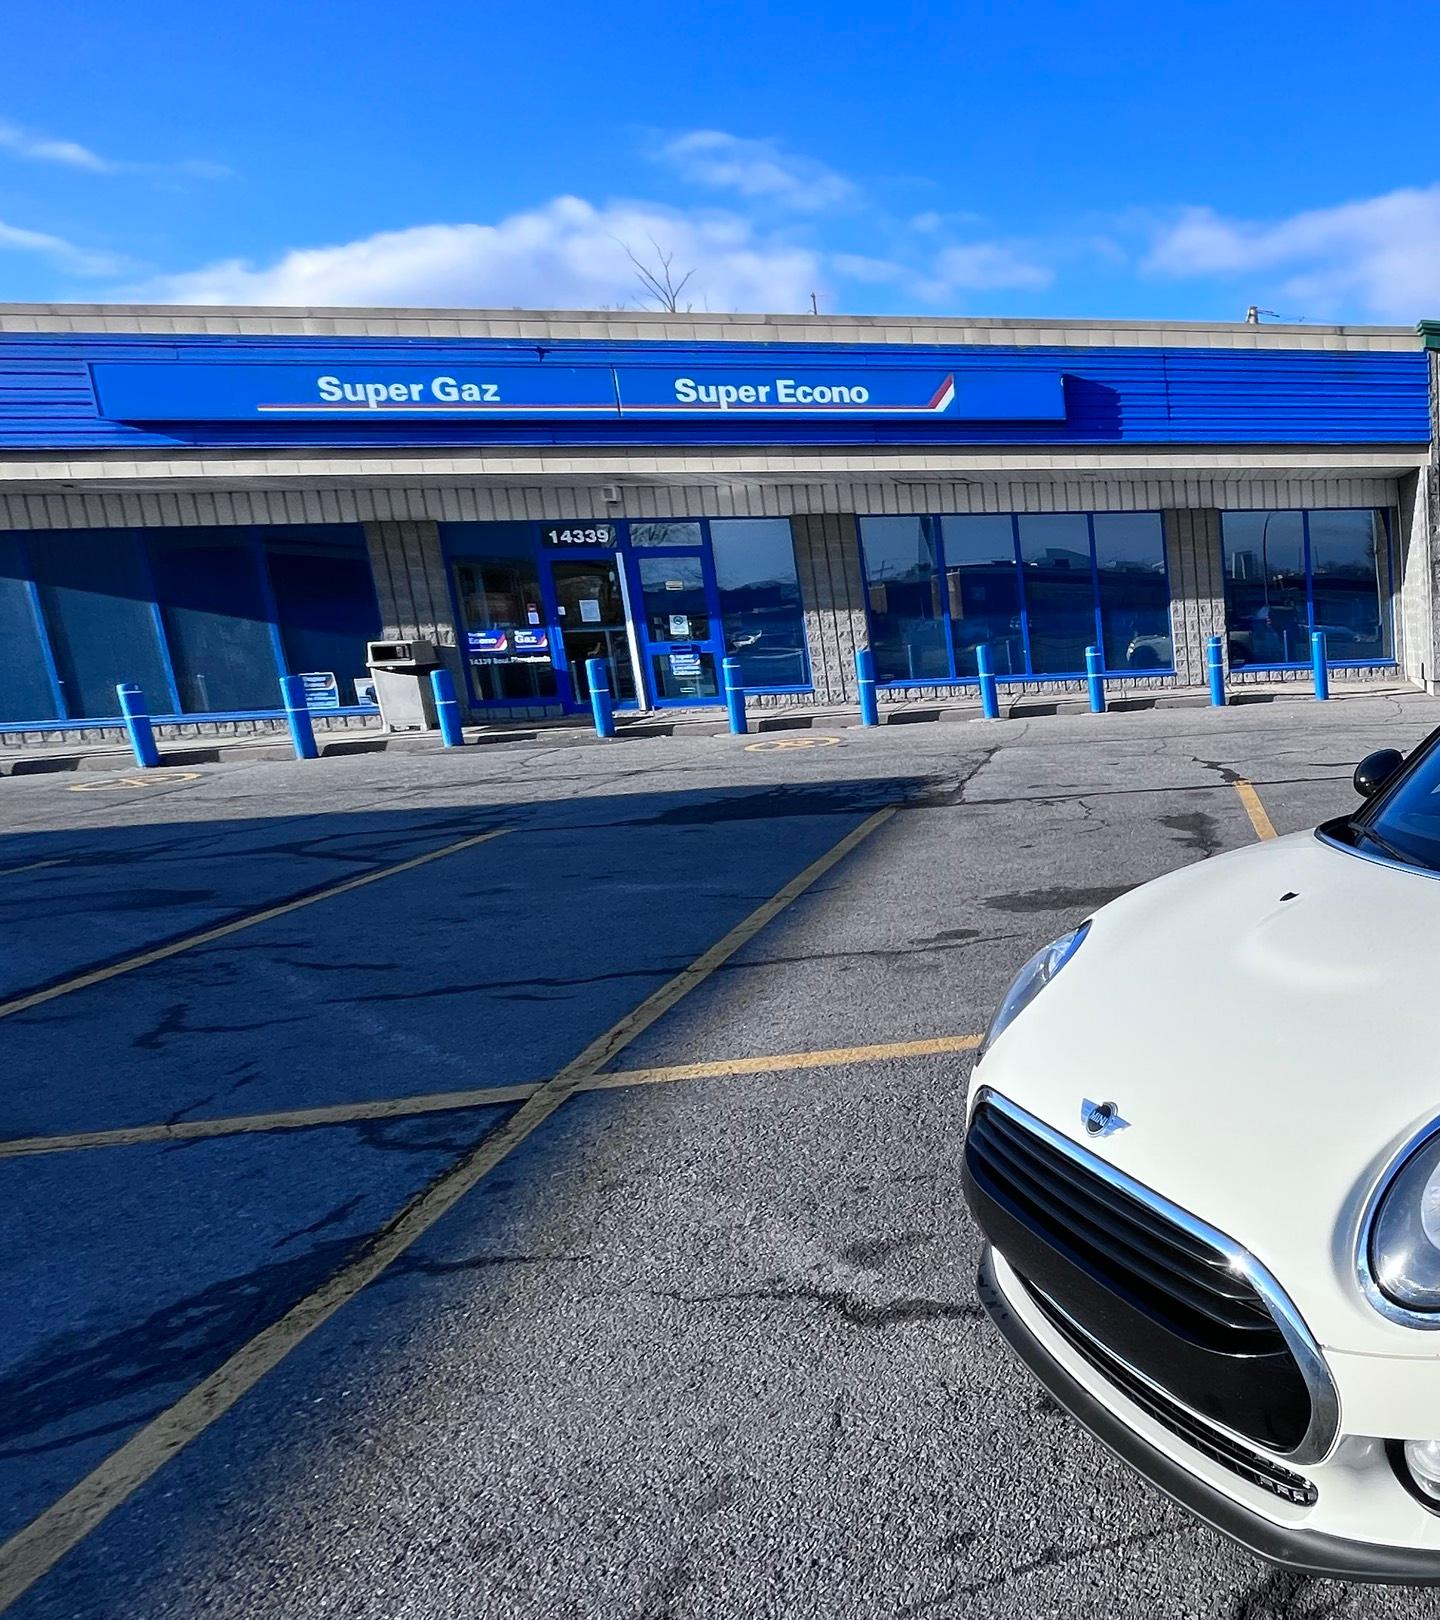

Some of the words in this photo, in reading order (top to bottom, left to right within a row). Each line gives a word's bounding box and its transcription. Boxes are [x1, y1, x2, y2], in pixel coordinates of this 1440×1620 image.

[317, 376, 424, 409] Super
[431, 376, 500, 402] Gaz
[674, 378, 770, 410] Super
[776, 379, 869, 404] Econo
[548, 529, 609, 544] 14339
[514, 635, 537, 643] Gaz
[1090, 1111, 1108, 1126] MINI
